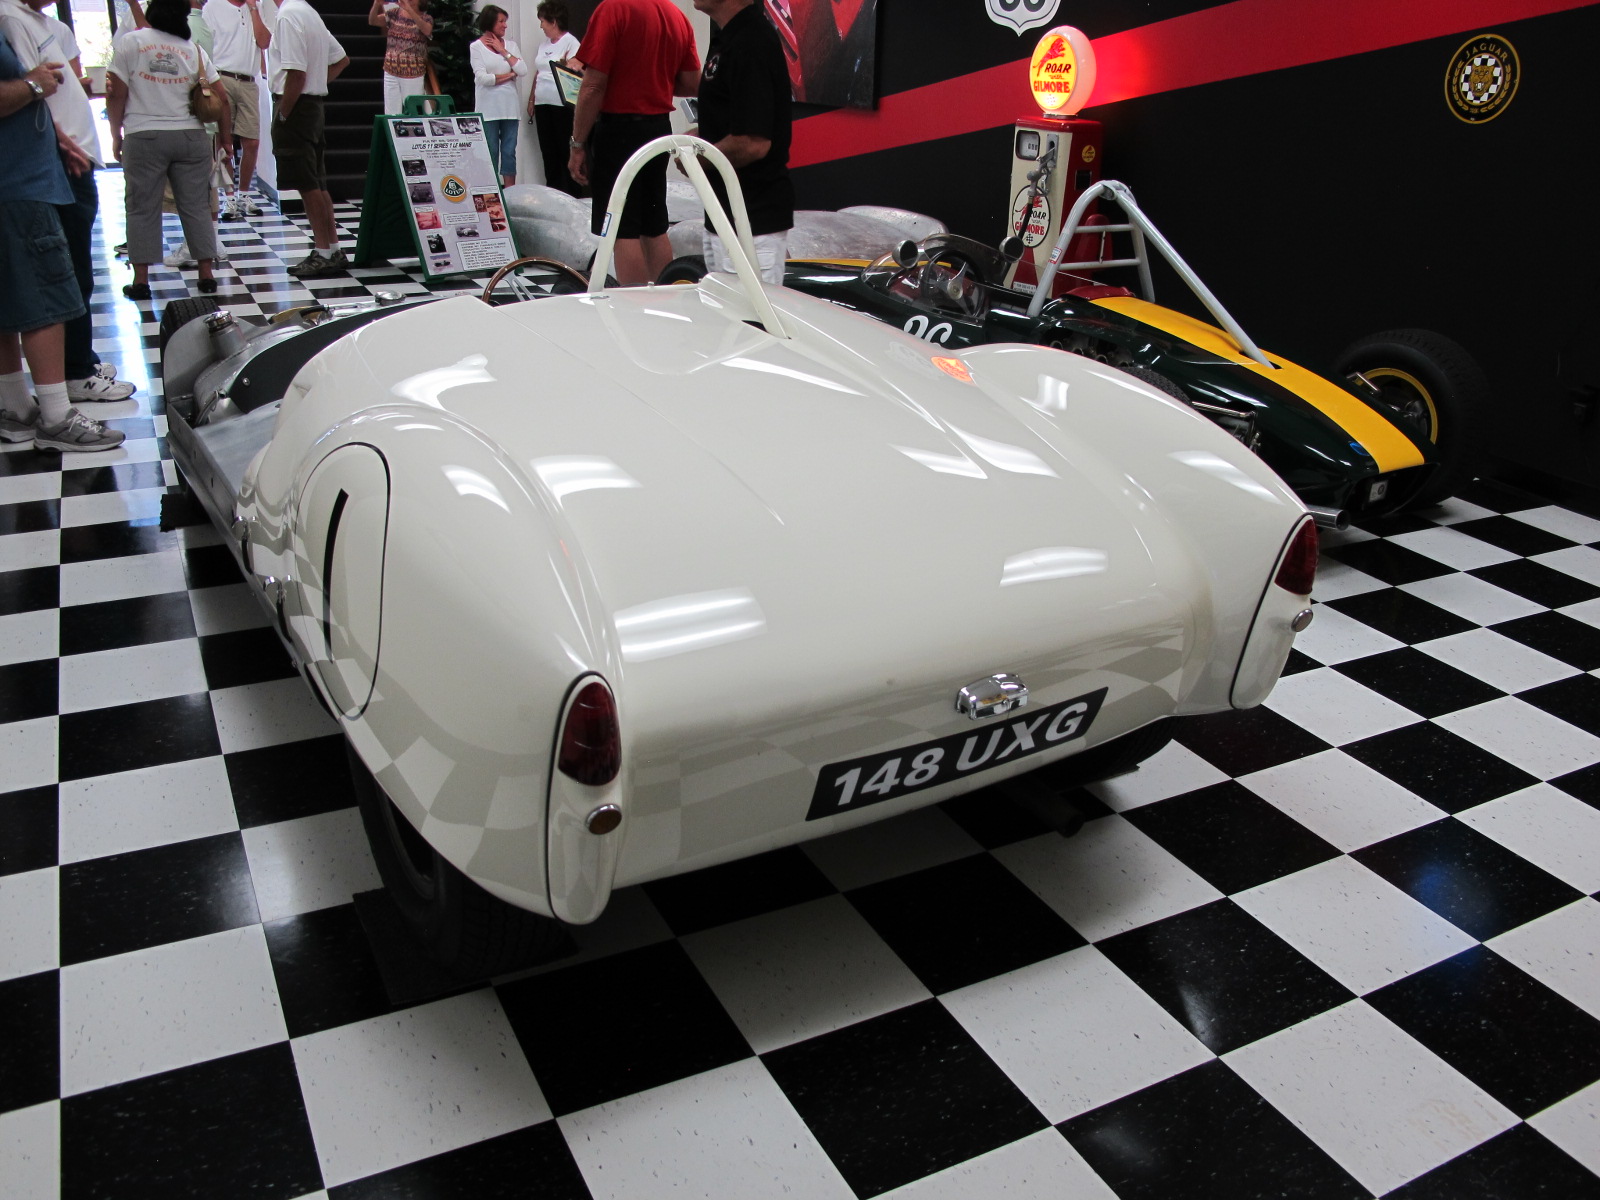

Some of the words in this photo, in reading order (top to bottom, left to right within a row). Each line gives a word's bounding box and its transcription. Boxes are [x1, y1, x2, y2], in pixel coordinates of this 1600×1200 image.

[138, 44, 157, 54] SIMI
[160, 44, 191, 61] VALLEY
[1465, 43, 1508, 62] JAGUAR
[1044, 62, 1072, 74] ROAR
[138, 71, 190, 85] CORVETTES
[1033, 80, 1071, 93] GILMORE
[445, 187, 465, 196] LOTUS
[83, 380, 97, 390] N
[834, 747, 945, 806] 148
[955, 701, 1089, 772] UXG
